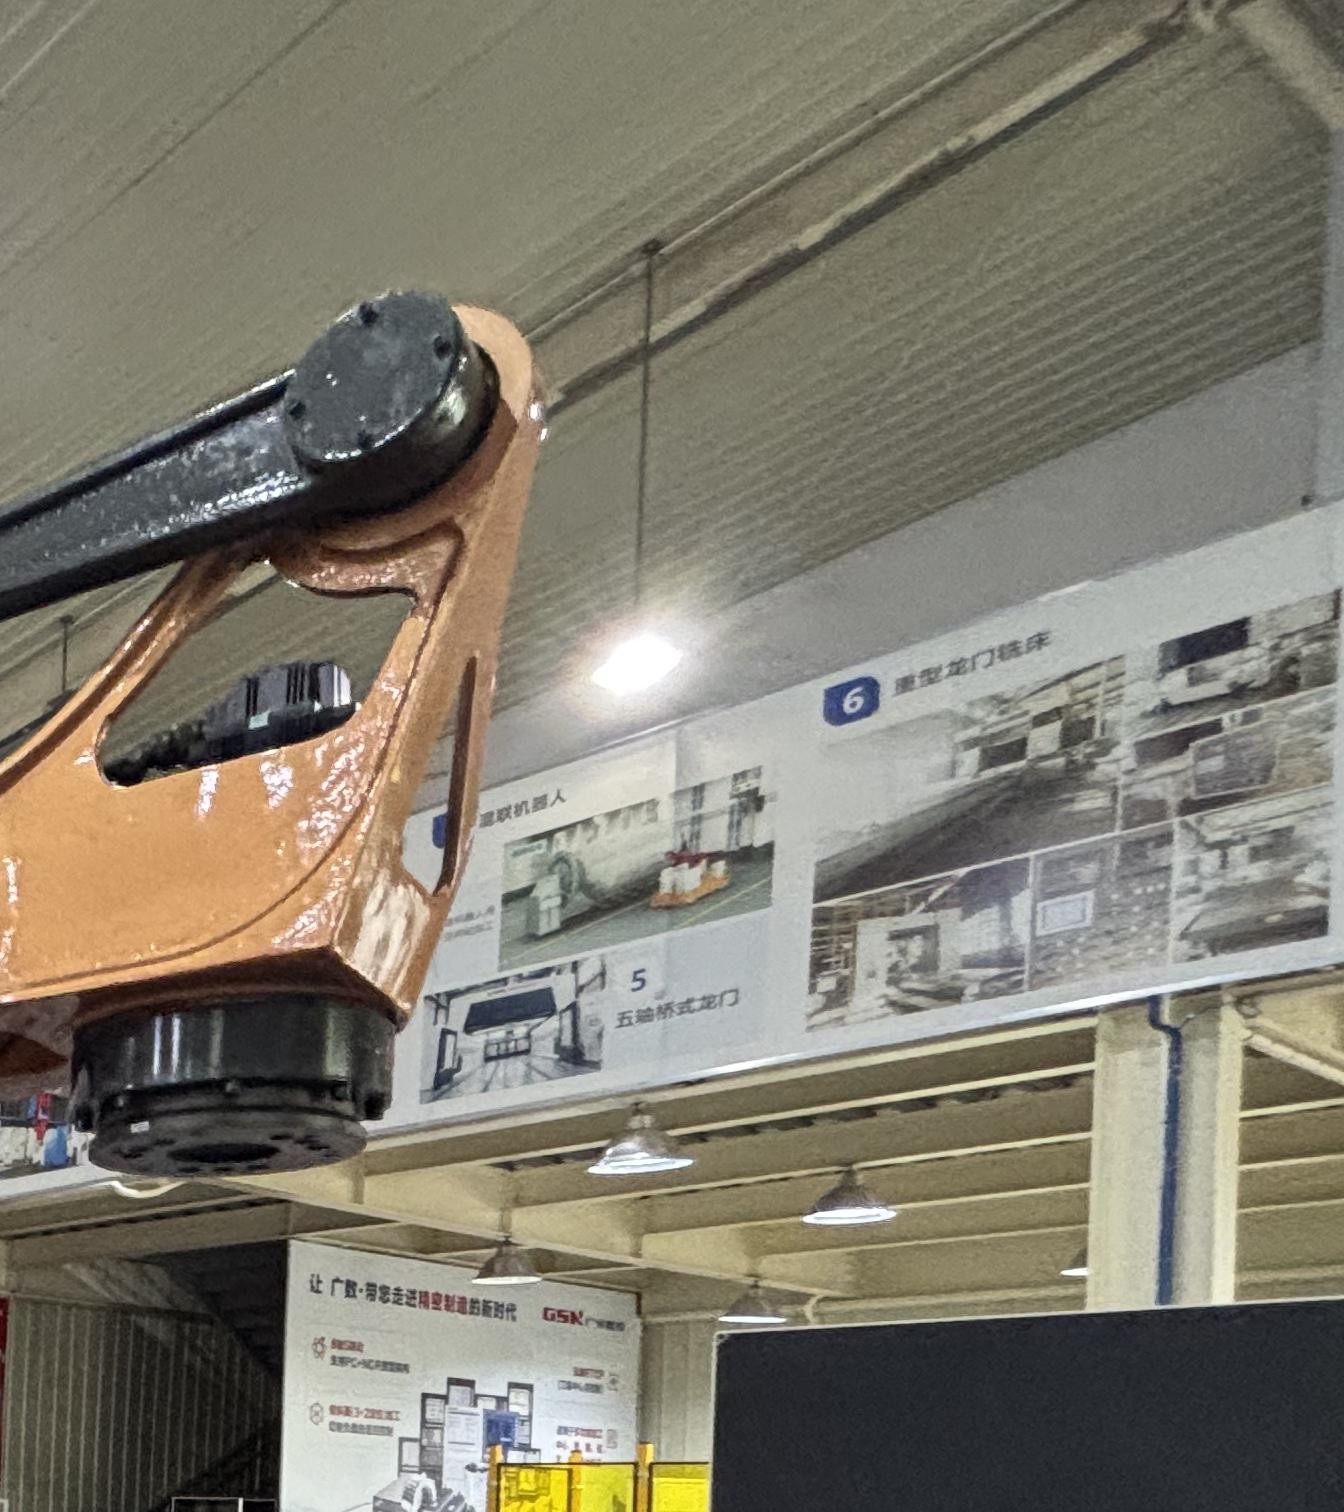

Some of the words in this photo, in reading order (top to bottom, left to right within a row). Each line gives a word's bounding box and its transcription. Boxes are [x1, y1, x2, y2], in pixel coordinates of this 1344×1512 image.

[842, 687, 865, 716] 6
[631, 968, 647, 992] 5
[309, 1273, 323, 1295] 让
[542, 1306, 584, 1326] GSK
